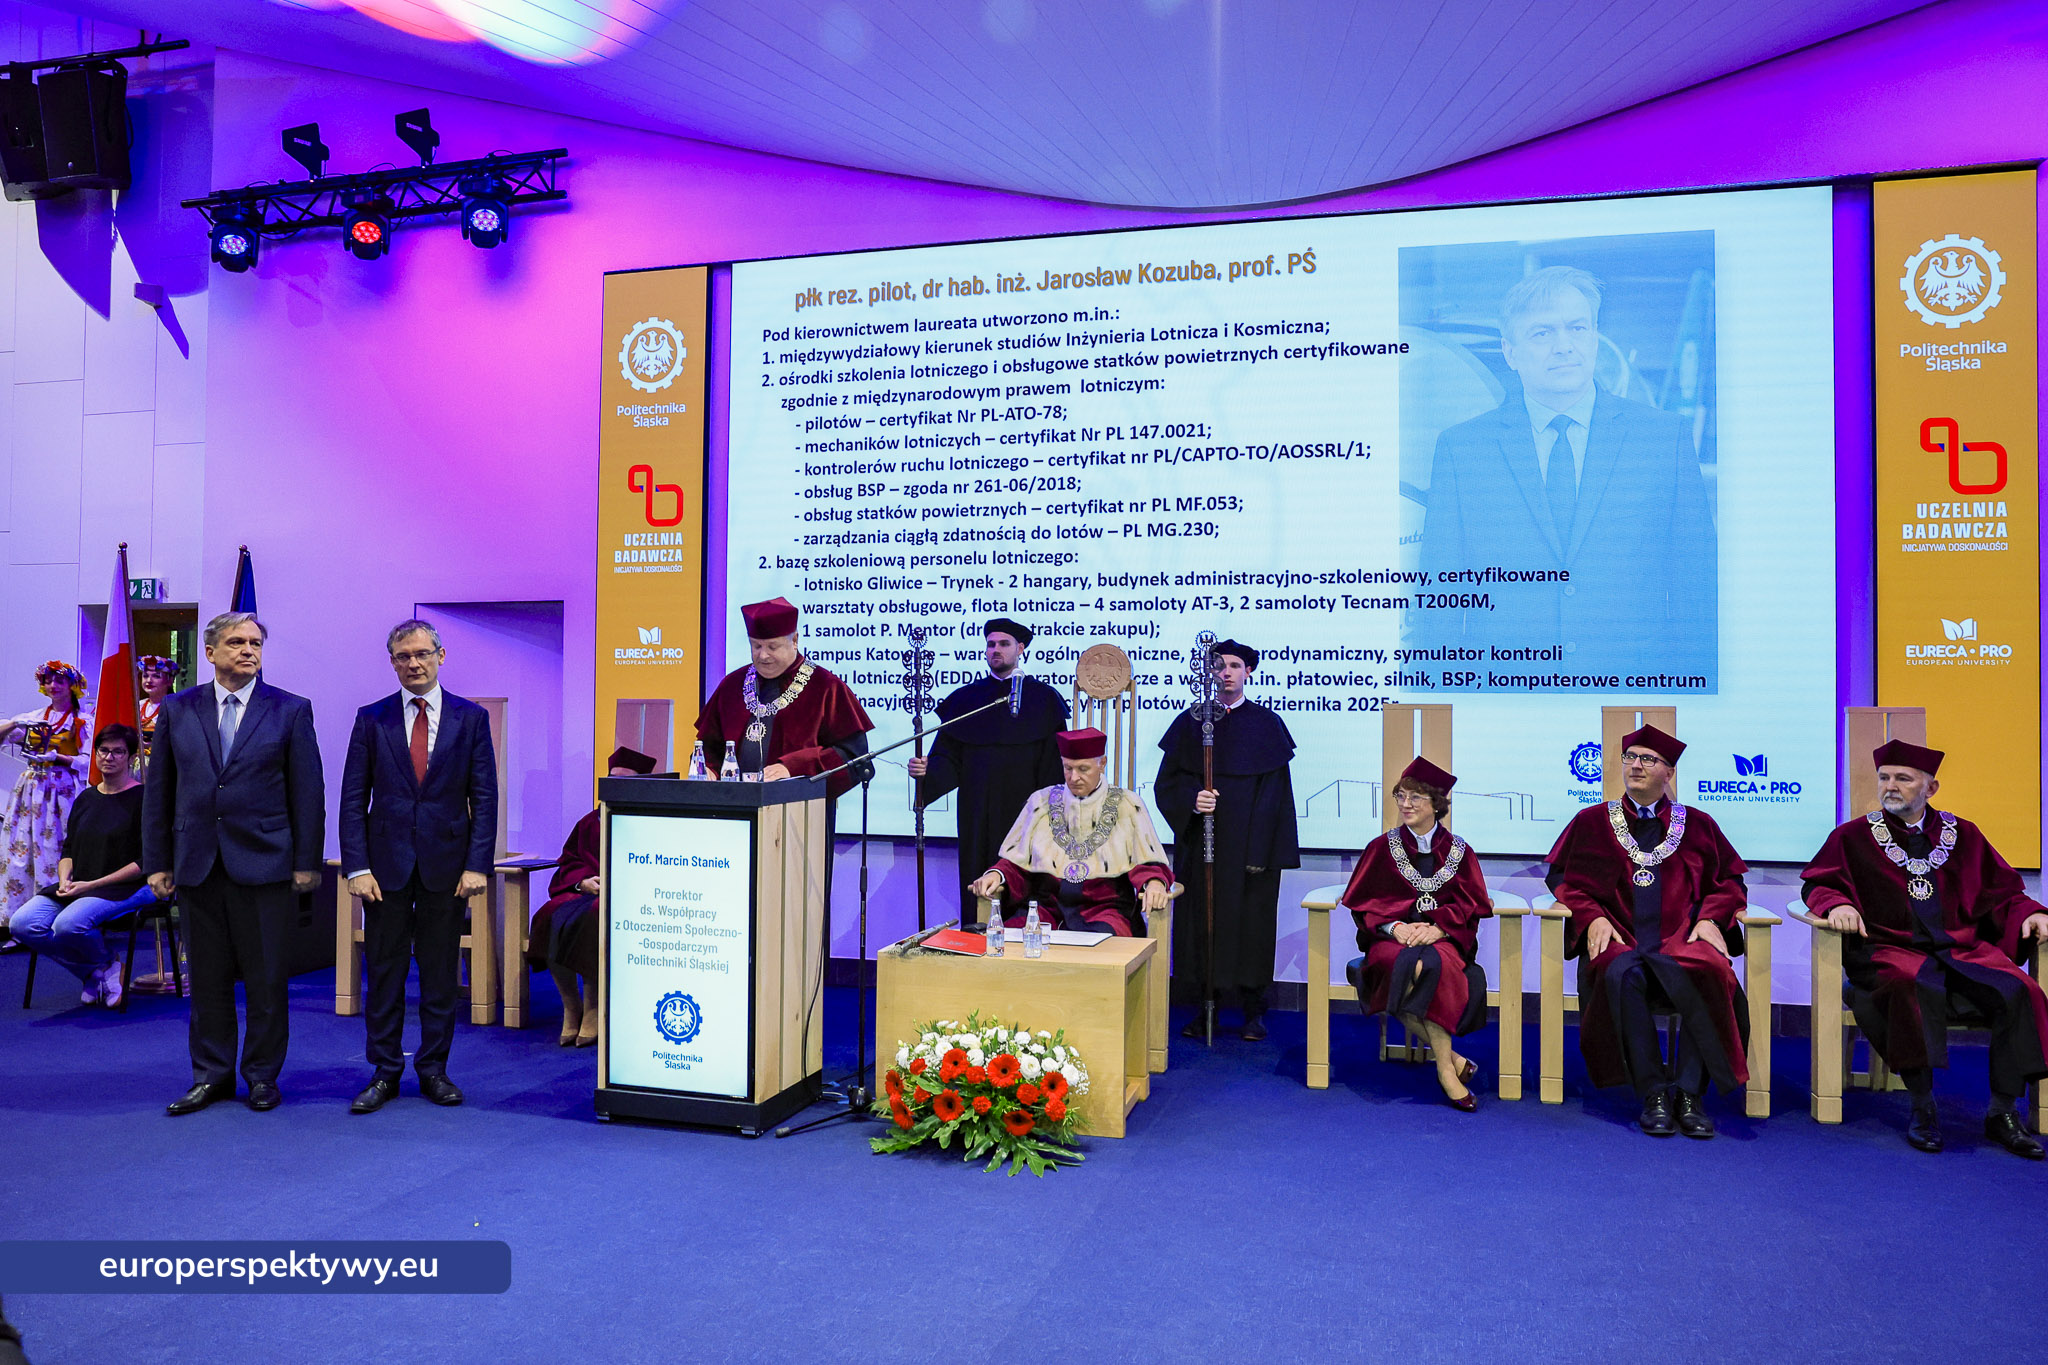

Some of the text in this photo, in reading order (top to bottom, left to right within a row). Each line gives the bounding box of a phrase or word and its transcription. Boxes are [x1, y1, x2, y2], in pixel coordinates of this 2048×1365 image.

[796, 247, 1316, 312] płk rez. pilot, dr hab. inż. Jarosław Kozuba, prof. PŚ
[763, 306, 1120, 342] Pod kierownictwem laureata utworzono m.in.:
[762, 320, 1330, 365] 1. międzywydziałowy kierunek studiów Inżynieria Lotnicza Kosmiczna;
[1900, 340, 2007, 358] Politechnika
[762, 342, 1410, 387] 2. ośrodki szkolenia lotniczego obsługowe statków powietrznych certyfikowane
[1926, 356, 1982, 372] Śląska
[781, 377, 1164, 411] zgodnie międzynarodowym prawem lotniczym:
[616, 402, 686, 417] Politechnika
[633, 414, 669, 428] Śląska
[806, 405, 1067, 434] pilotów certyfikat Nr PL-ATO-78;
[805, 423, 1211, 453] mechaników lotniczych certyfikat Nr PL 147.0021;
[805, 440, 1370, 476] kontrolerów ruchu lotniczego certyfikat nr PL/CAPTO-TO/AOSSRL/1;
[804, 476, 1081, 500] obsług BSP zgoda nr 261-06/2018;
[804, 496, 1243, 524] obsług statków powietrznych certyfikat nr PL MF.053;
[1916, 501, 2008, 519] UCZELNIA
[624, 532, 683, 547] UCZELNIA
[804, 522, 1219, 548] zarządzania ciągłą zdatnością do lotów PL MG.230;
[1902, 522, 2008, 540] BADAWCZA
[1902, 541, 2008, 552] INICJATYWA DOSKONAŁOŚCI
[614, 548, 683, 564] BADAWCZA
[758, 550, 1078, 572] 2. bazę szkoleniową personelu lotniczego:
[804, 566, 1570, 592] lotnisko Gliwice Trynek hangary, budynek administracyjno-szkoleniowy, certyfikowane
[802, 593, 1495, 616] warsztaty obsługowe, flota lotnicza samoloty AT-3, samoloty Tecnam T2006M,
[802, 624, 810, 637] 1
[816, 623, 876, 637] samolot
[881, 624, 892, 636] P.
[1030, 621, 1085, 636] trakcie
[1090, 620, 1160, 639] zakupu);
[614, 647, 684, 659] EURECA PRO
[804, 646, 862, 664] kampus
[1393, 645, 1484, 664] symulator
[1490, 644, 1563, 661] kontroli
[1905, 644, 2012, 658] EURECA PRO
[1287, 670, 1378, 689] płatowiec,
[1384, 671, 1436, 689] silnik,
[1442, 671, 1482, 690] BSP;
[1488, 671, 1620, 690] komputerowe
[1625, 674, 1707, 688] centrum
[1698, 780, 1802, 795] EURECA PRO
[1698, 794, 1800, 803] EUROPEAN UNIVERSITY
[628, 852, 730, 869] Prof. Marcin Staniek
[654, 888, 703, 901] Prorektor
[640, 904, 717, 921] ds. Współpracy
[615, 920, 742, 940] z Otoczeniem Społeczno-
[638, 938, 718, 955] -Gospodarczym
[627, 953, 729, 974] Politechniki Śląskiej
[652, 1050, 703, 1064] Politechnika
[664, 1060, 691, 1071] Śląska
